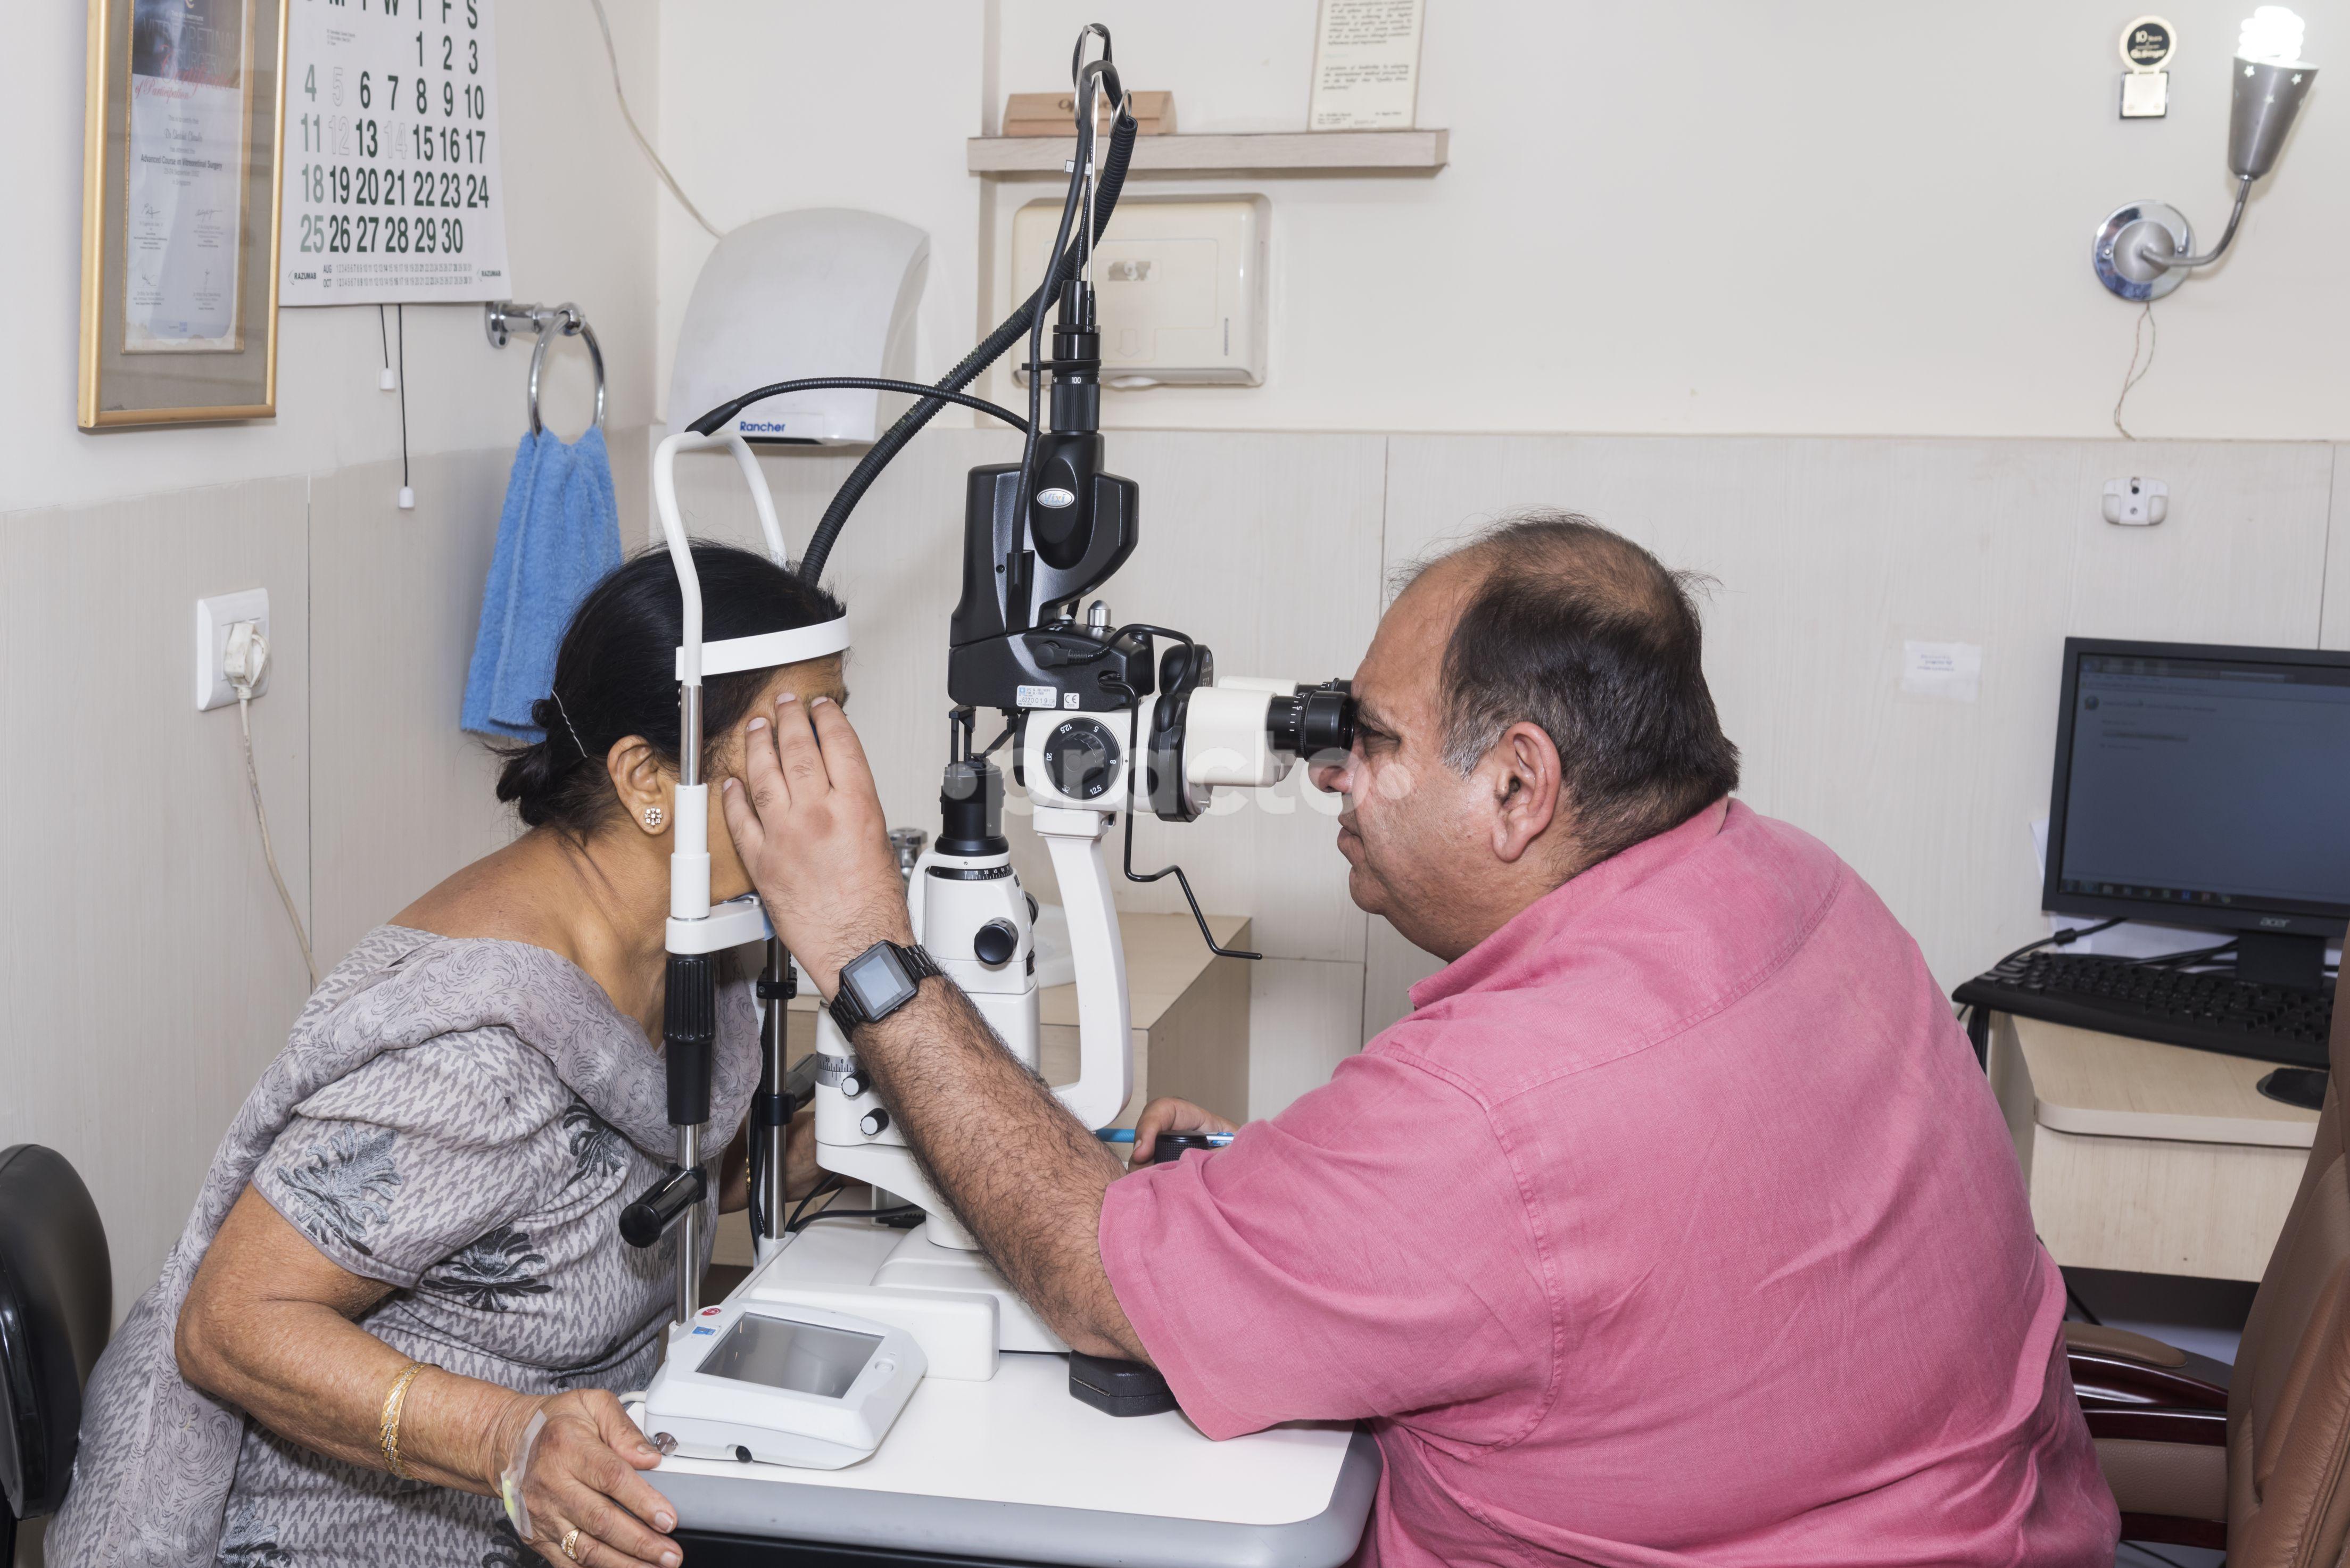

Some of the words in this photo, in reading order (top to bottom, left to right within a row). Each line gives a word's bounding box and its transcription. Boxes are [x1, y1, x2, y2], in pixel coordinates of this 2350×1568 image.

[416, 31, 423, 67] 1
[443, 35, 453, 71] 2
[469, 39, 478, 74] 3
[305, 64, 317, 102] 4
[333, 67, 343, 106] 5
[360, 71, 371, 109] 6
[388, 74, 399, 111] 7
[417, 78, 427, 114] 8
[443, 81, 453, 117] 9
[465, 84, 484, 120] 10
[301, 113, 320, 152] 11
[329, 115, 350, 155] 12
[356, 119, 378, 158] 13
[384, 121, 407, 159] 14
[413, 124, 434, 161] 15
[440, 126, 460, 163] 16
[466, 129, 485, 164] 17
[141, 154, 161, 164] Advanced
[162, 155, 176, 165] Course
[208, 161, 222, 171] Surgery
[302, 164, 324, 203] 18
[329, 165, 350, 204] 19
[356, 167, 378, 205] 20
[384, 169, 405, 205] 21
[413, 170, 435, 206] 22
[440, 172, 461, 209] 23
[467, 173, 489, 209] 24
[300, 214, 324, 253] 25
[329, 214, 350, 253] 26
[357, 215, 379, 253] 27
[385, 217, 409, 253] 28
[415, 217, 436, 254] 29
[442, 218, 463, 254] 30
[324, 264, 332, 273] AUG
[323, 278, 332, 287] OCT
[740, 420, 787, 433] Rancher
[1044, 493, 1067, 504] Vixi
[1060, 724, 1072, 734] 12.5
[1046, 752, 1052, 761] 20
[1062, 785, 1070, 793] 32
[1090, 785, 1102, 794] 12.5
[2260, 917, 2290, 927] acer
